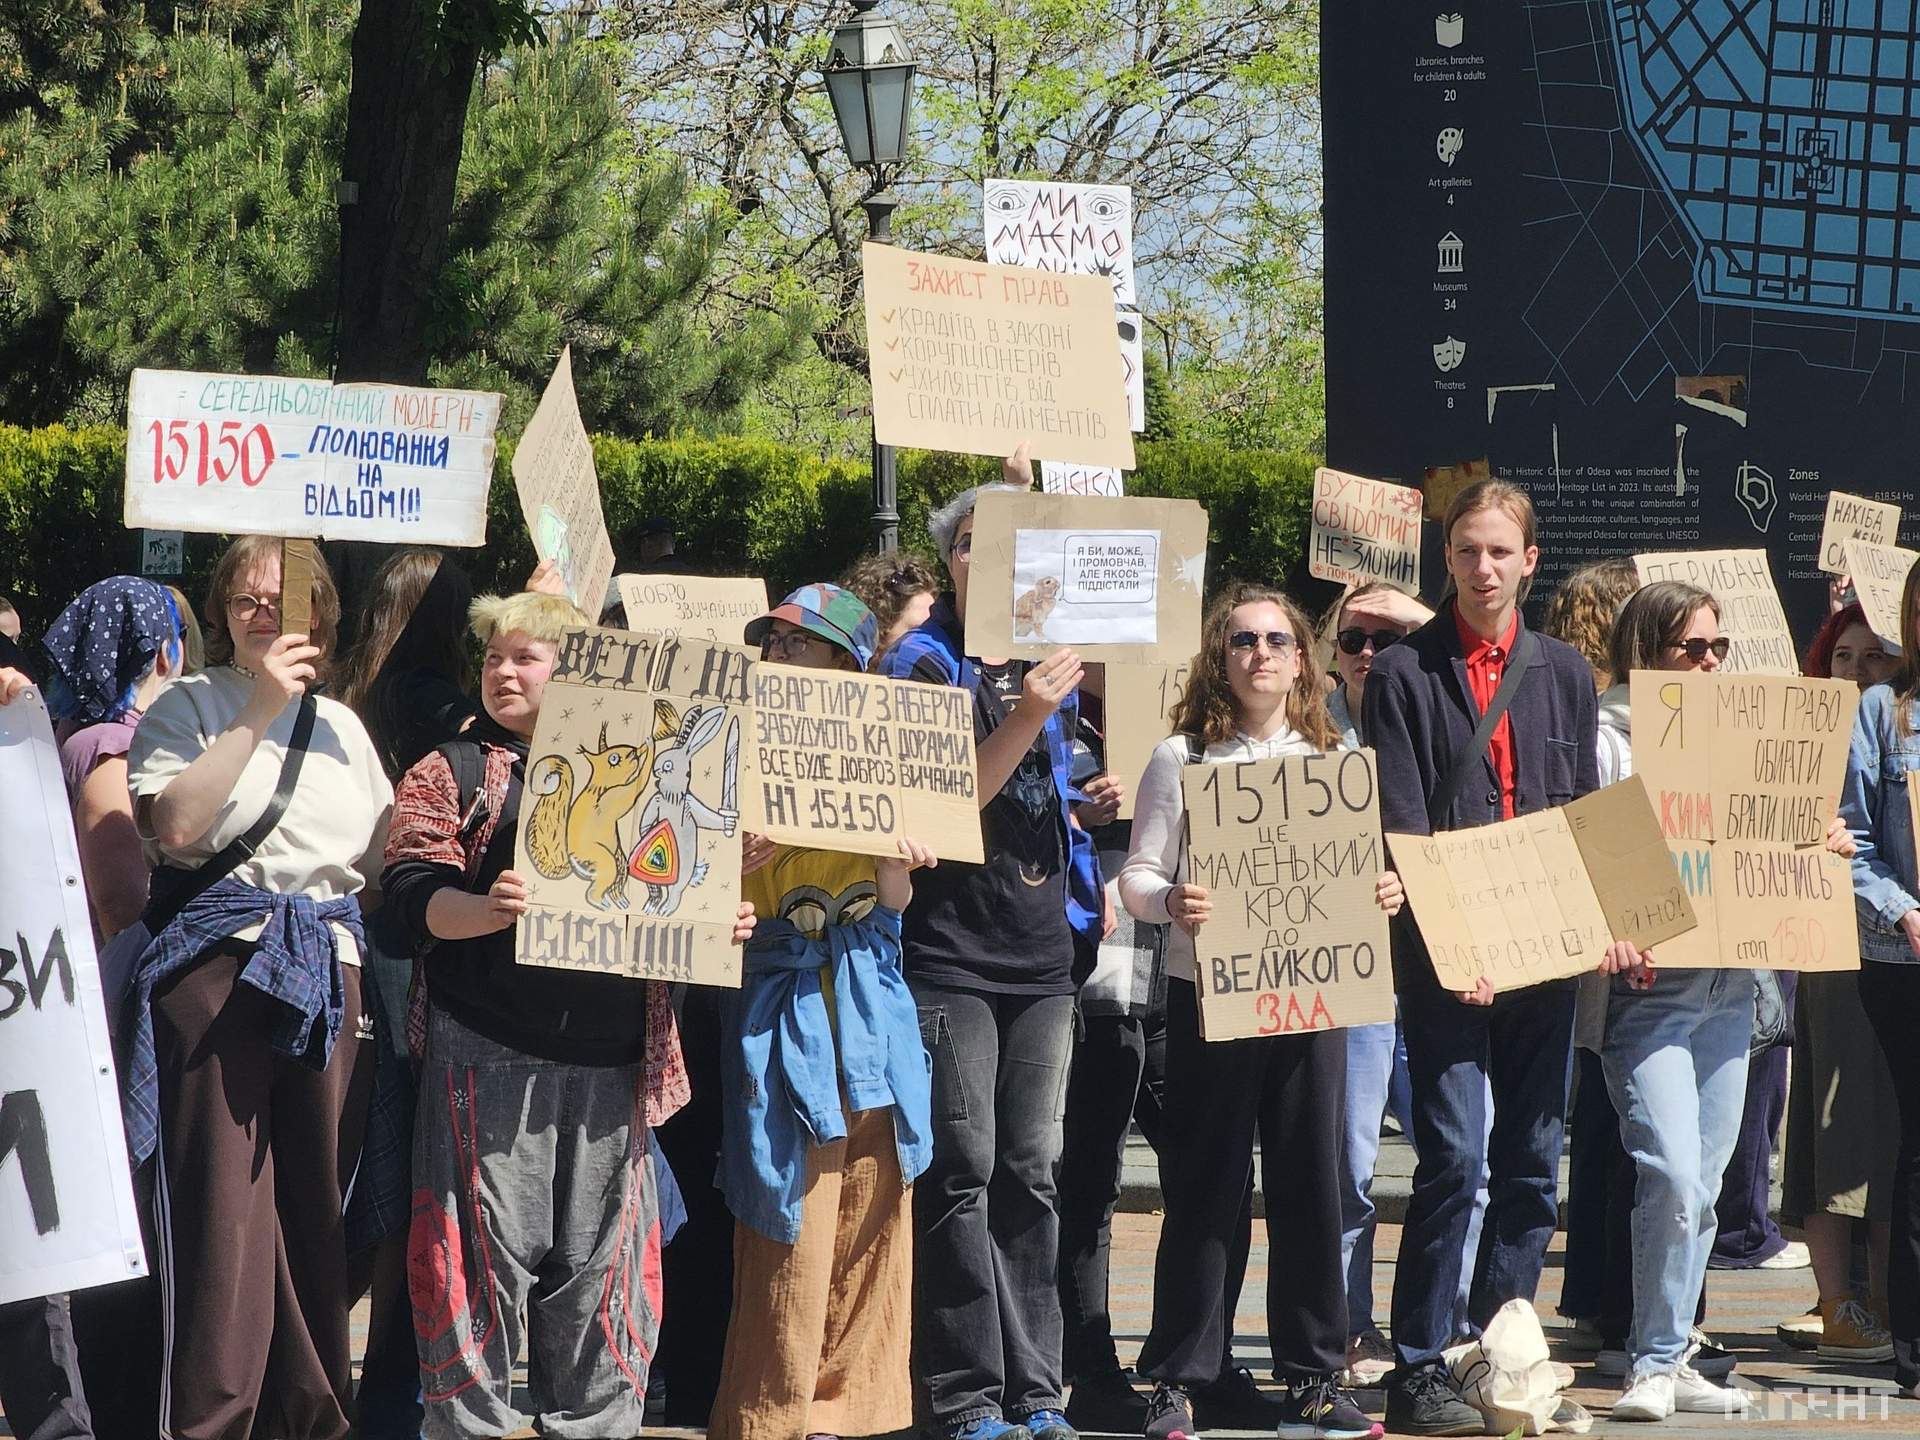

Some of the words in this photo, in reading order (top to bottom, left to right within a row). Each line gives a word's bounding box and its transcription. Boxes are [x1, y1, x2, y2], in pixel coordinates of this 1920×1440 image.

[1416, 56, 1449, 67] Libraries,
[1450, 54, 1485, 65] branches
[1414, 72, 1424, 82] for
[1425, 72, 1455, 82] children
[1456, 71, 1462, 80] &
[1463, 70, 1487, 80] adults
[1444, 89, 1457, 101] 20
[1428, 177, 1440, 187] Art
[1441, 176, 1473, 189] galleries
[1028, 187, 1081, 224] МИ
[1447, 194, 1454, 206] 4
[992, 219, 1124, 260] МАЄМО
[907, 261, 987, 299] ЗАХИСТ
[1003, 275, 1070, 306] ПРАВ
[1433, 282, 1468, 292] Museums
[1444, 298, 1456, 311] 34
[901, 307, 976, 341] КРАДІЇВ
[987, 318, 1000, 343] В
[1005, 319, 1072, 350] ЗАКОНІ
[901, 336, 1062, 378] КОРУПЦІОНЕРІВ
[1434, 380, 1467, 390] Theatres
[199, 379, 386, 425] СЕРЕДНЬОВІЧНИЙ
[1447, 397, 1454, 408] 8
[907, 392, 984, 426] СПЛАТИ
[993, 401, 1107, 440] АЛІМЕНТІВ
[148, 419, 275, 487] 15150
[308, 424, 450, 470] ПОЛЮВАННЯ
[357, 463, 383, 488] НА
[1499, 466, 1513, 476] The
[1516, 466, 1544, 476] Historic
[1576, 466, 1584, 476] of
[1587, 466, 1611, 476] Odesa
[1636, 466, 1670, 476] inscribed
[1687, 466, 1700, 476] the
[1788, 468, 1820, 481] Zones
[1319, 471, 1386, 509] БУТИ
[1534, 482, 1556, 492] World
[1559, 482, 1590, 495] Heritage
[1592, 482, 1606, 492] List
[1608, 482, 1617, 492] in
[1619, 482, 1640, 493] 2023.
[1642, 482, 1652, 492] Its
[1789, 492, 1813, 502] World
[304, 483, 421, 523] ВІДЬОМ!!!
[1536, 498, 1557, 508] value
[1562, 498, 1574, 508] lies
[1580, 498, 1587, 508] in
[1592, 498, 1605, 508] the
[1610, 498, 1635, 511] unique
[1640, 498, 1686, 508] combination
[1692, 498, 1700, 508] of
[1832, 499, 1884, 532] НАХІБА
[1545, 514, 1567, 524] urban
[1610, 514, 1641, 525] cultures,
[1642, 514, 1683, 527] languages,
[1684, 514, 1700, 524] and
[1546, 530, 1564, 540] have
[1565, 530, 1593, 543] shaped
[1593, 530, 1617, 540] Odesa
[1618, 530, 1628, 540] for
[1666, 529, 1700, 540] UNESCO
[1788, 532, 1818, 542] Central
[1078, 546, 1085, 556] Я
[1088, 546, 1105, 557] БИ,
[1108, 546, 1144, 557] МОЖЕ,
[1316, 532, 1342, 567] НЕ
[1551, 546, 1563, 555] the
[1565, 546, 1584, 555] state
[1585, 546, 1600, 555] and
[1079, 558, 1147, 568] ПРОМОВЧАВ,
[1080, 569, 1100, 579] АЛЕ
[1103, 569, 1139, 579] ЯКОСЬ
[1078, 580, 1140, 592] ПІДДІСТАЛИ
[551, 630, 682, 694] ВЕТО
[690, 644, 756, 705] НА
[754, 673, 869, 719] КВАРТИРУ
[1659, 682, 1684, 750] Я
[1716, 684, 1766, 730] МАЮ
[1782, 685, 1842, 733] ПРАВО
[755, 710, 858, 752] ЗАБУДУЮТЬ
[759, 746, 791, 778] ВСЕ
[794, 751, 834, 782] БУДЕ
[1203, 750, 1373, 827] 15150
[809, 787, 895, 834] 15150
[1660, 790, 1714, 839] КИМ
[1726, 793, 1778, 842] БРАТИ
[1258, 824, 1289, 845] ЦЕ
[1193, 832, 1378, 890] МАЛЕНЬКИЙ
[1245, 884, 1328, 929] КРОК
[1261, 927, 1299, 952] ДО
[1211, 941, 1375, 995] ВЕЛИКОГО
[1256, 990, 1336, 1035] ЗЛА
